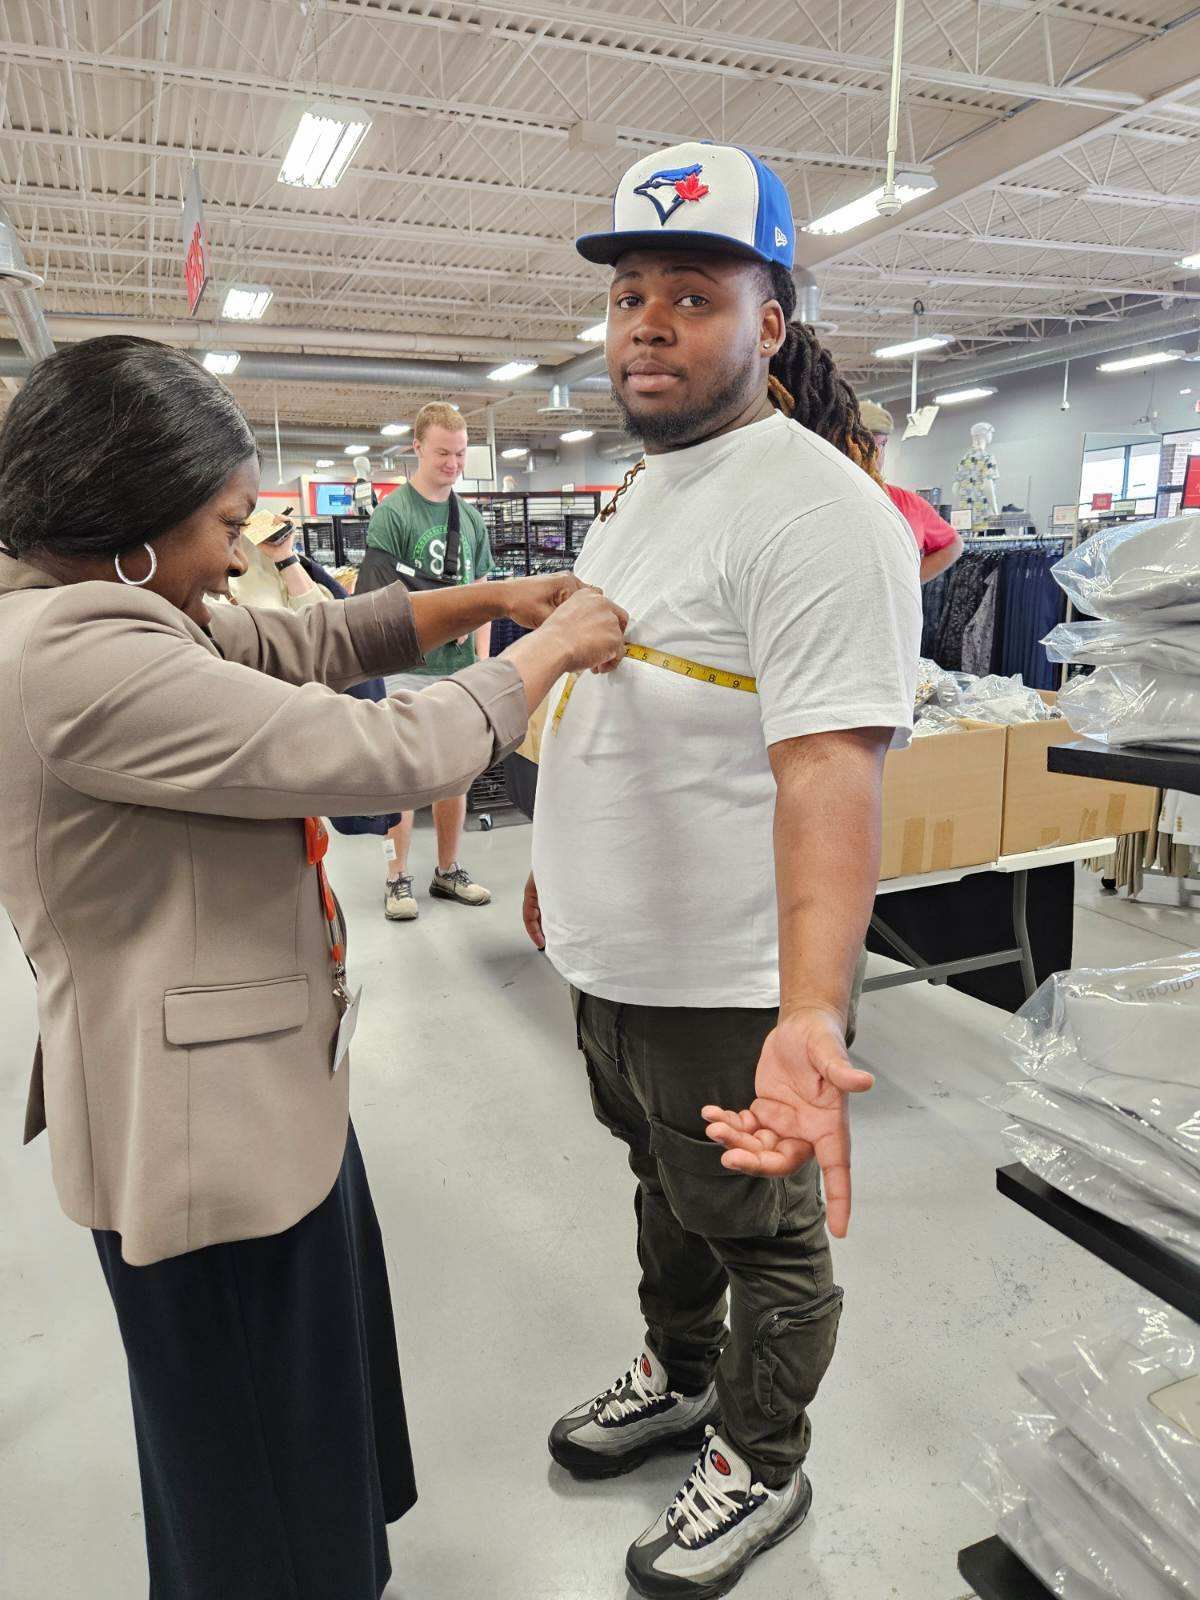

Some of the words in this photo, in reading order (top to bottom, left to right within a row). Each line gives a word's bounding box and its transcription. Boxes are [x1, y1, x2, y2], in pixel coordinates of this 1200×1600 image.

[641, 653, 648, 661] 5
[685, 666, 692, 675] 7
[708, 674, 716, 683] 8
[732, 680, 740, 689] 9
